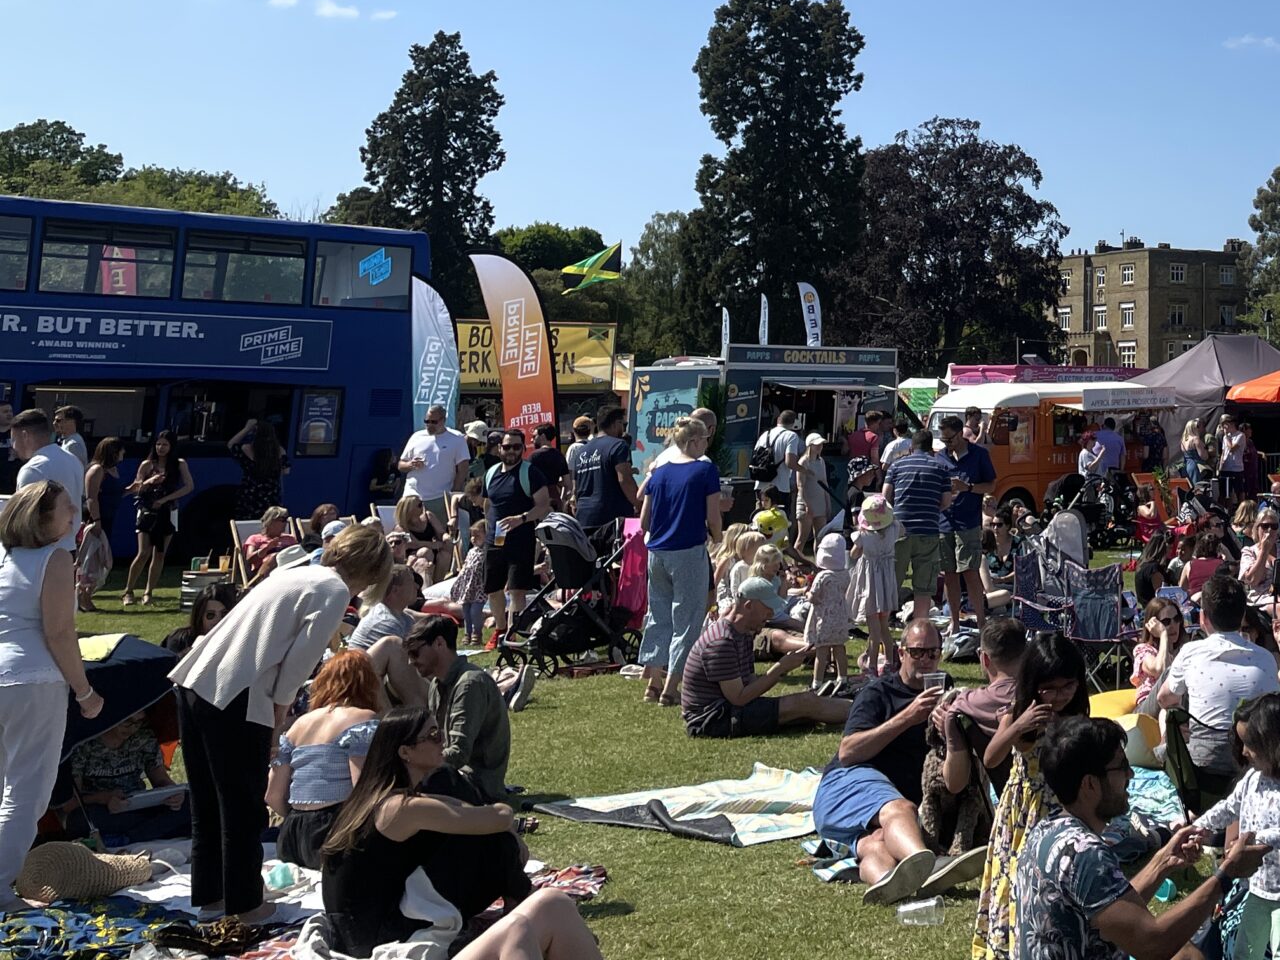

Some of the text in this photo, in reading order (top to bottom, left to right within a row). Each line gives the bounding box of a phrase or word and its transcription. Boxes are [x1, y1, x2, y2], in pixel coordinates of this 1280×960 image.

[0, 314, 205, 339] R. BUT BETTER.
[38, 340, 119, 349] AWARD WINNING
[243, 329, 288, 347] PRIME
[265, 341, 300, 357] TIME
[783, 350, 847, 364] COCKTAILS
[460, 351, 492, 374] ERK
[88, 764, 137, 777] MINECRAF
